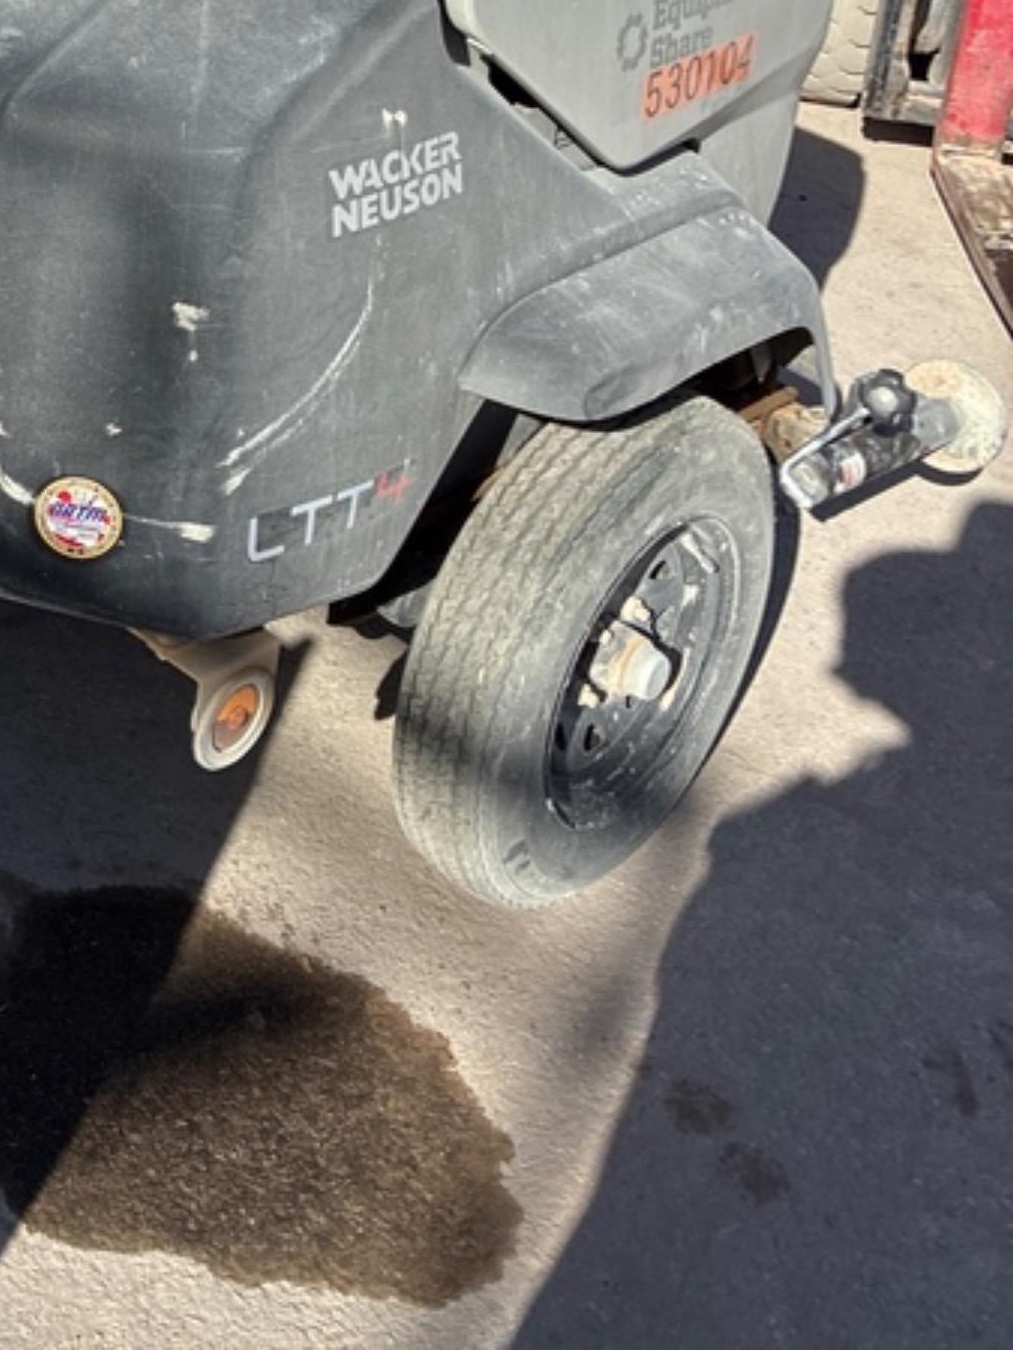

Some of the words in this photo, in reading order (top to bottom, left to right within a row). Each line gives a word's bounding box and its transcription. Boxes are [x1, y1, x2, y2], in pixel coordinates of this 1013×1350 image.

[643, 34, 756, 119] 530104
[649, 25, 715, 68] Share
[327, 131, 462, 200] WACKER
[331, 162, 464, 238] NEUSON
